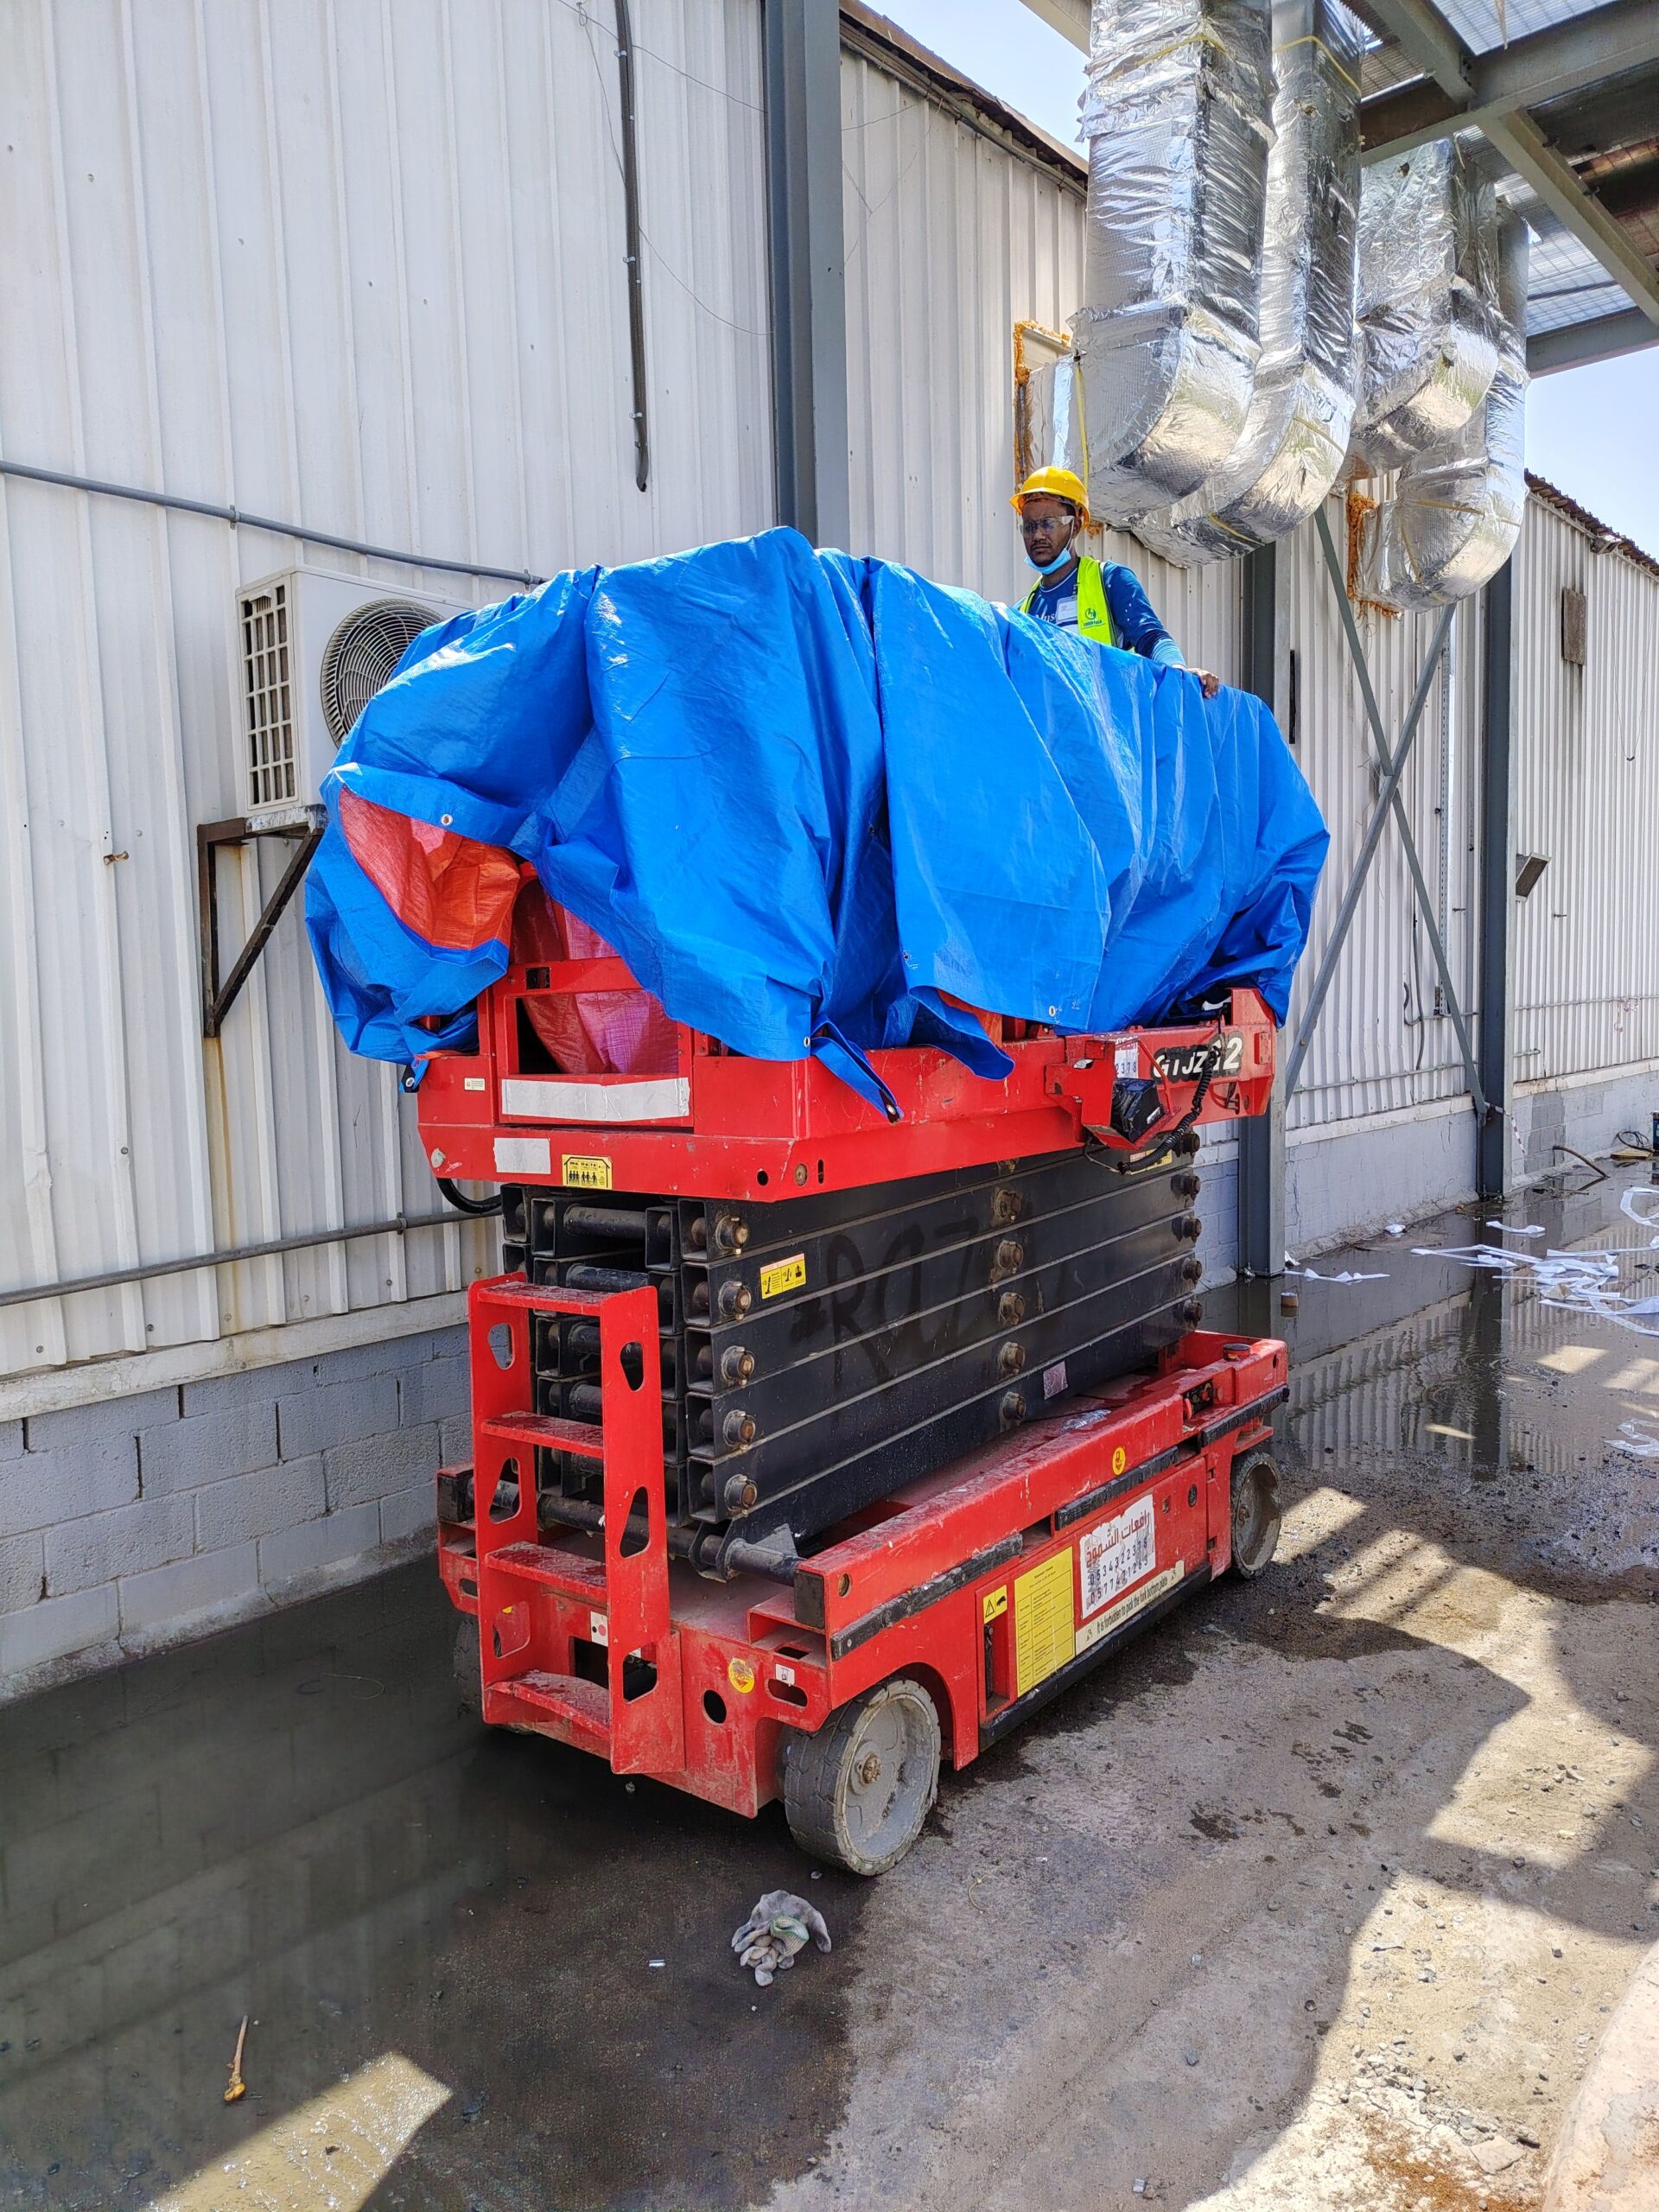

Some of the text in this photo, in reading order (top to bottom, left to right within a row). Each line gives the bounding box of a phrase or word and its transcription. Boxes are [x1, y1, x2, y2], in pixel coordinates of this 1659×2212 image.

[1086, 1509, 1150, 1568] رافعات الشموخ
[1104, 1608, 1122, 1628] forbidden
